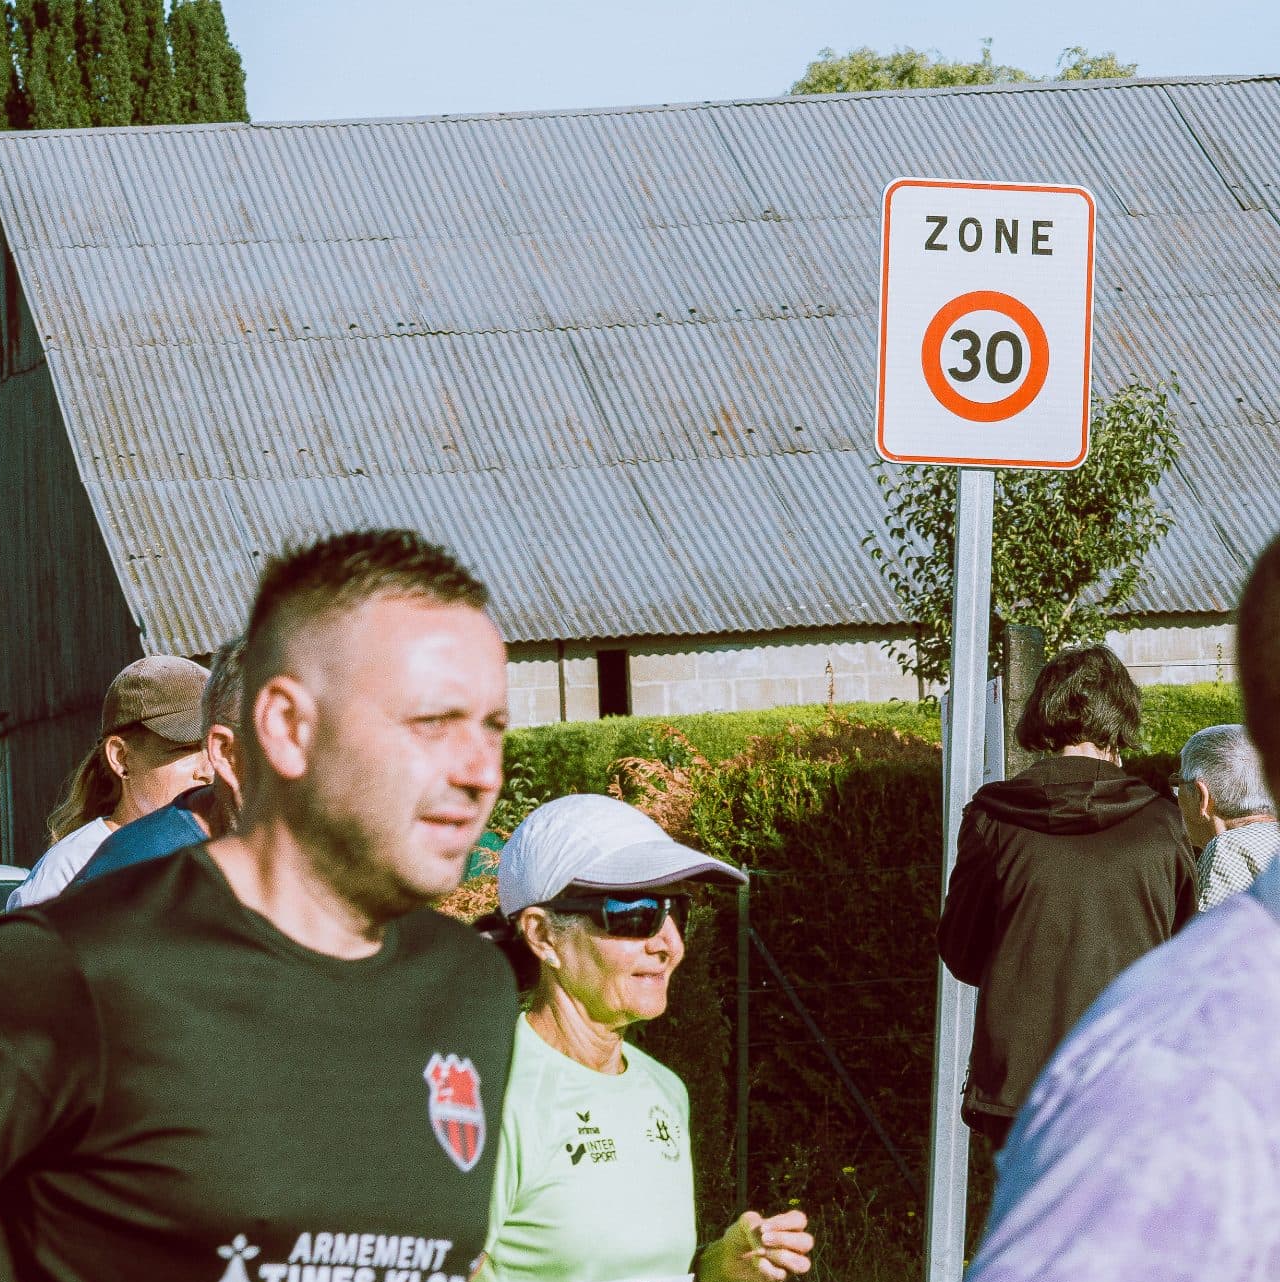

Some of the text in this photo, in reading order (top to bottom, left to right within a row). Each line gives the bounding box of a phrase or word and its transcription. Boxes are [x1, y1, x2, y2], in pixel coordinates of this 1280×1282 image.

[924, 215, 1054, 256] ZONE
[947, 329, 1024, 384] 30
[587, 1138, 615, 1152] INTER
[590, 1150, 617, 1163] SPORT
[288, 1232, 453, 1272] ARMEMENT
